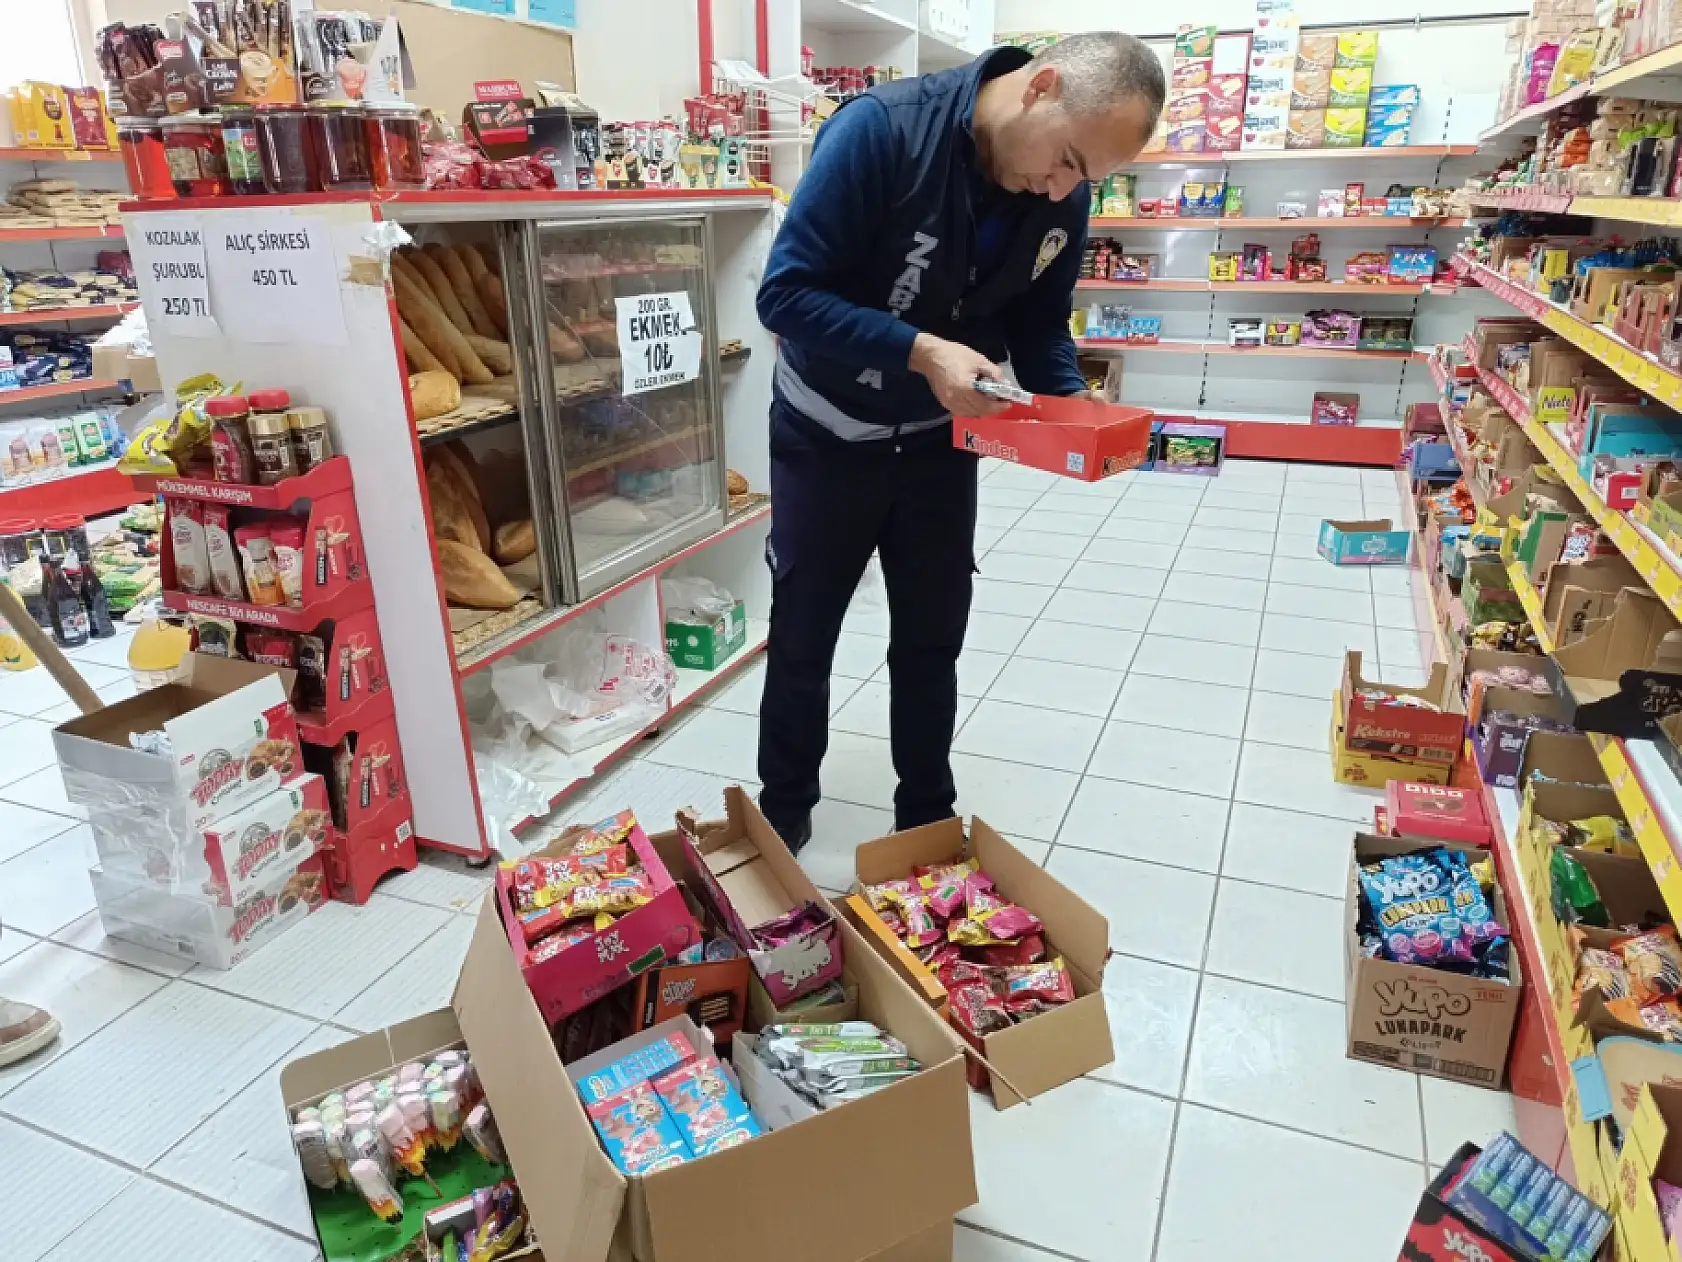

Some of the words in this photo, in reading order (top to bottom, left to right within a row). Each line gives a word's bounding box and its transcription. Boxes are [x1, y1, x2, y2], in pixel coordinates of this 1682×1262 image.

[145, 230, 201, 246] KOZALAK
[226, 234, 255, 254] ALIÇ
[258, 227, 310, 250] SİRKESİ
[252, 269, 277, 286] 450
[279, 269, 298, 286] TL
[162, 297, 190, 315] 250
[193, 297, 207, 316] TL
[638, 299, 656, 313] 200
[156, 480, 210, 498] MÜKEMMEL
[211, 488, 252, 504] KARIŞIM
[246, 608, 280, 625] ARADA
[1374, 1021, 1468, 1044] LUNAPARK
